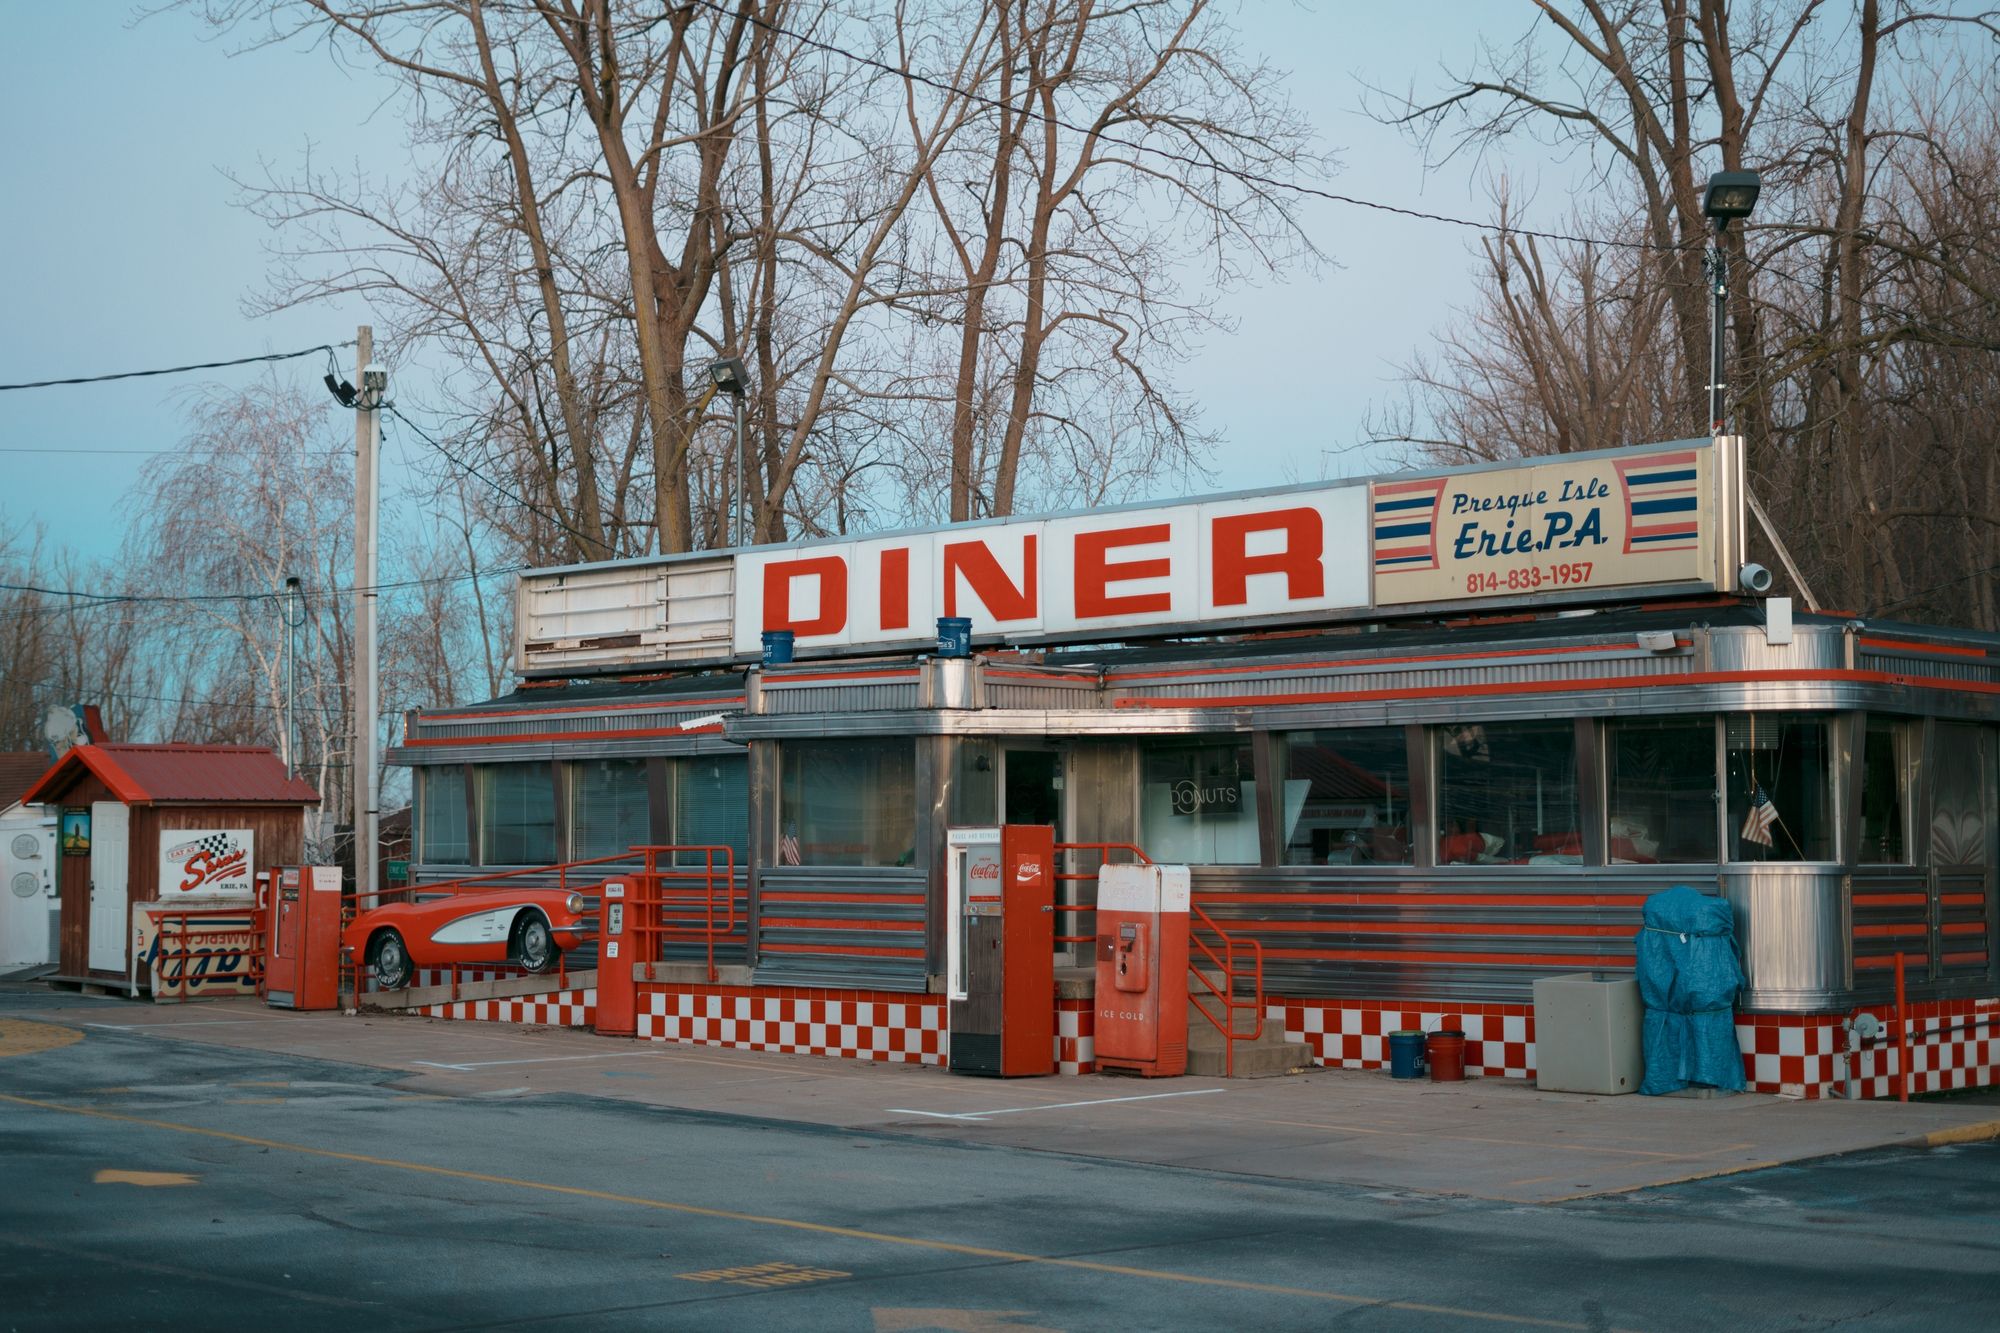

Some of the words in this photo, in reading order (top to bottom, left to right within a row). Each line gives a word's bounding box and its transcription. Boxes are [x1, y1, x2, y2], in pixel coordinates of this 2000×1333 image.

[1452, 490, 1549, 517] Presque
[1558, 477, 1610, 502] Isle
[763, 506, 1324, 638] DINER
[1466, 562, 1593, 593] 814-833-1957
[1170, 787, 1237, 806] DONUTS
[1100, 1008, 1115, 1019] ICE
[1119, 1011, 1144, 1021] COLD
